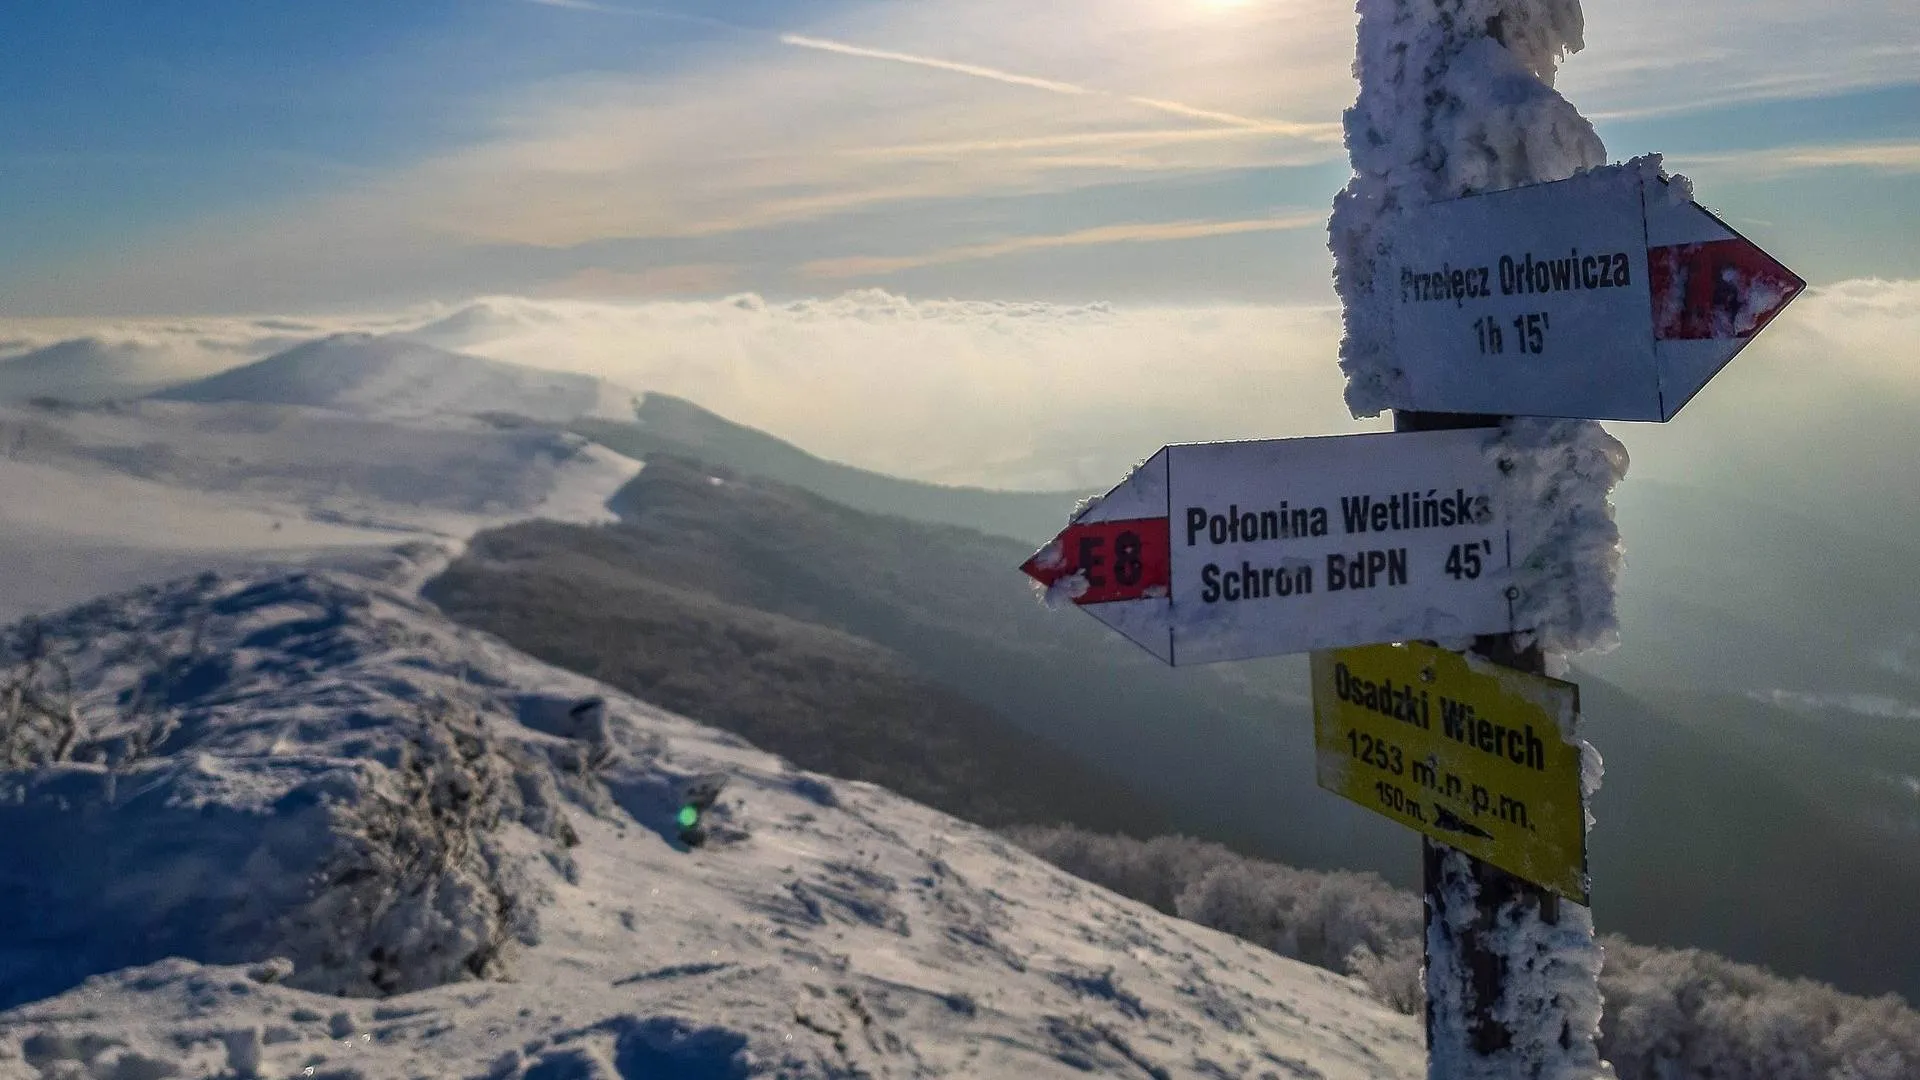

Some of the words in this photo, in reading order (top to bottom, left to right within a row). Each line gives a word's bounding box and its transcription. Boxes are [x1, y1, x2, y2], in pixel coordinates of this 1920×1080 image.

[1499, 248, 1631, 296] Orłowicza
[1472, 315, 1502, 354] 1h
[1187, 501, 1328, 546] Połonina
[1079, 531, 1141, 587] E8
[1201, 560, 1312, 603] Schron
[1327, 548, 1407, 591] BdPN
[1334, 662, 1429, 730] Osadzki
[1440, 696, 1544, 771] Wierch
[1347, 728, 1403, 776] 1253
